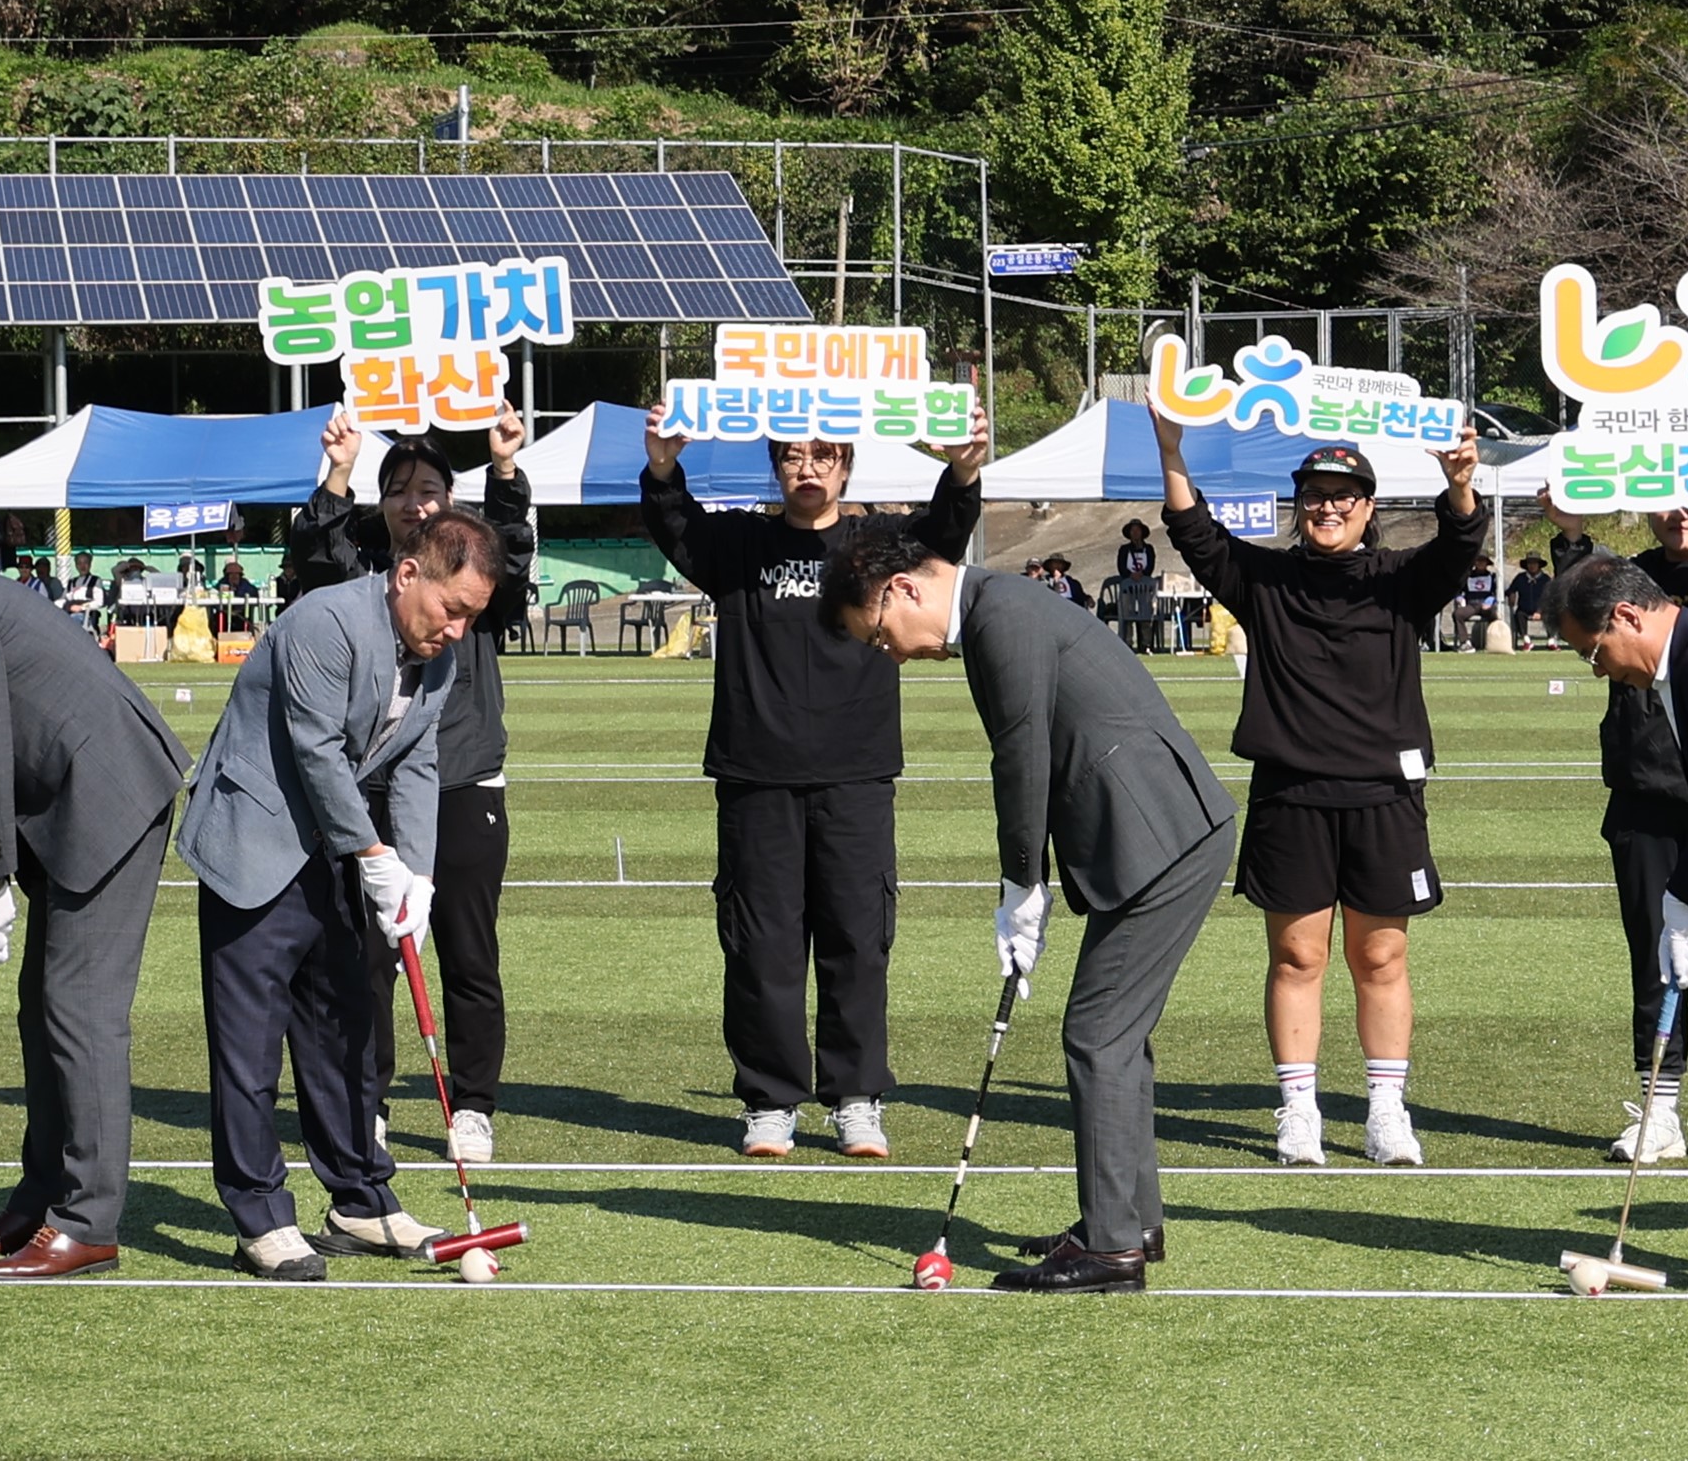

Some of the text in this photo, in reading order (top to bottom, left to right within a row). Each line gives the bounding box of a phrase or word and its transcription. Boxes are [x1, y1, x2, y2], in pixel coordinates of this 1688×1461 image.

[721, 331, 919, 380] 국민에게
[349, 350, 500, 425] 확산
[1313, 374, 1413, 397] 국민과 함께하는
[663, 386, 969, 437] 사랑받는 농협
[1309, 395, 1455, 441] 농심천심
[1592, 409, 1661, 434] 국민과
[147, 503, 225, 530] 옥종면
[1209, 499, 1273, 529] 천면
